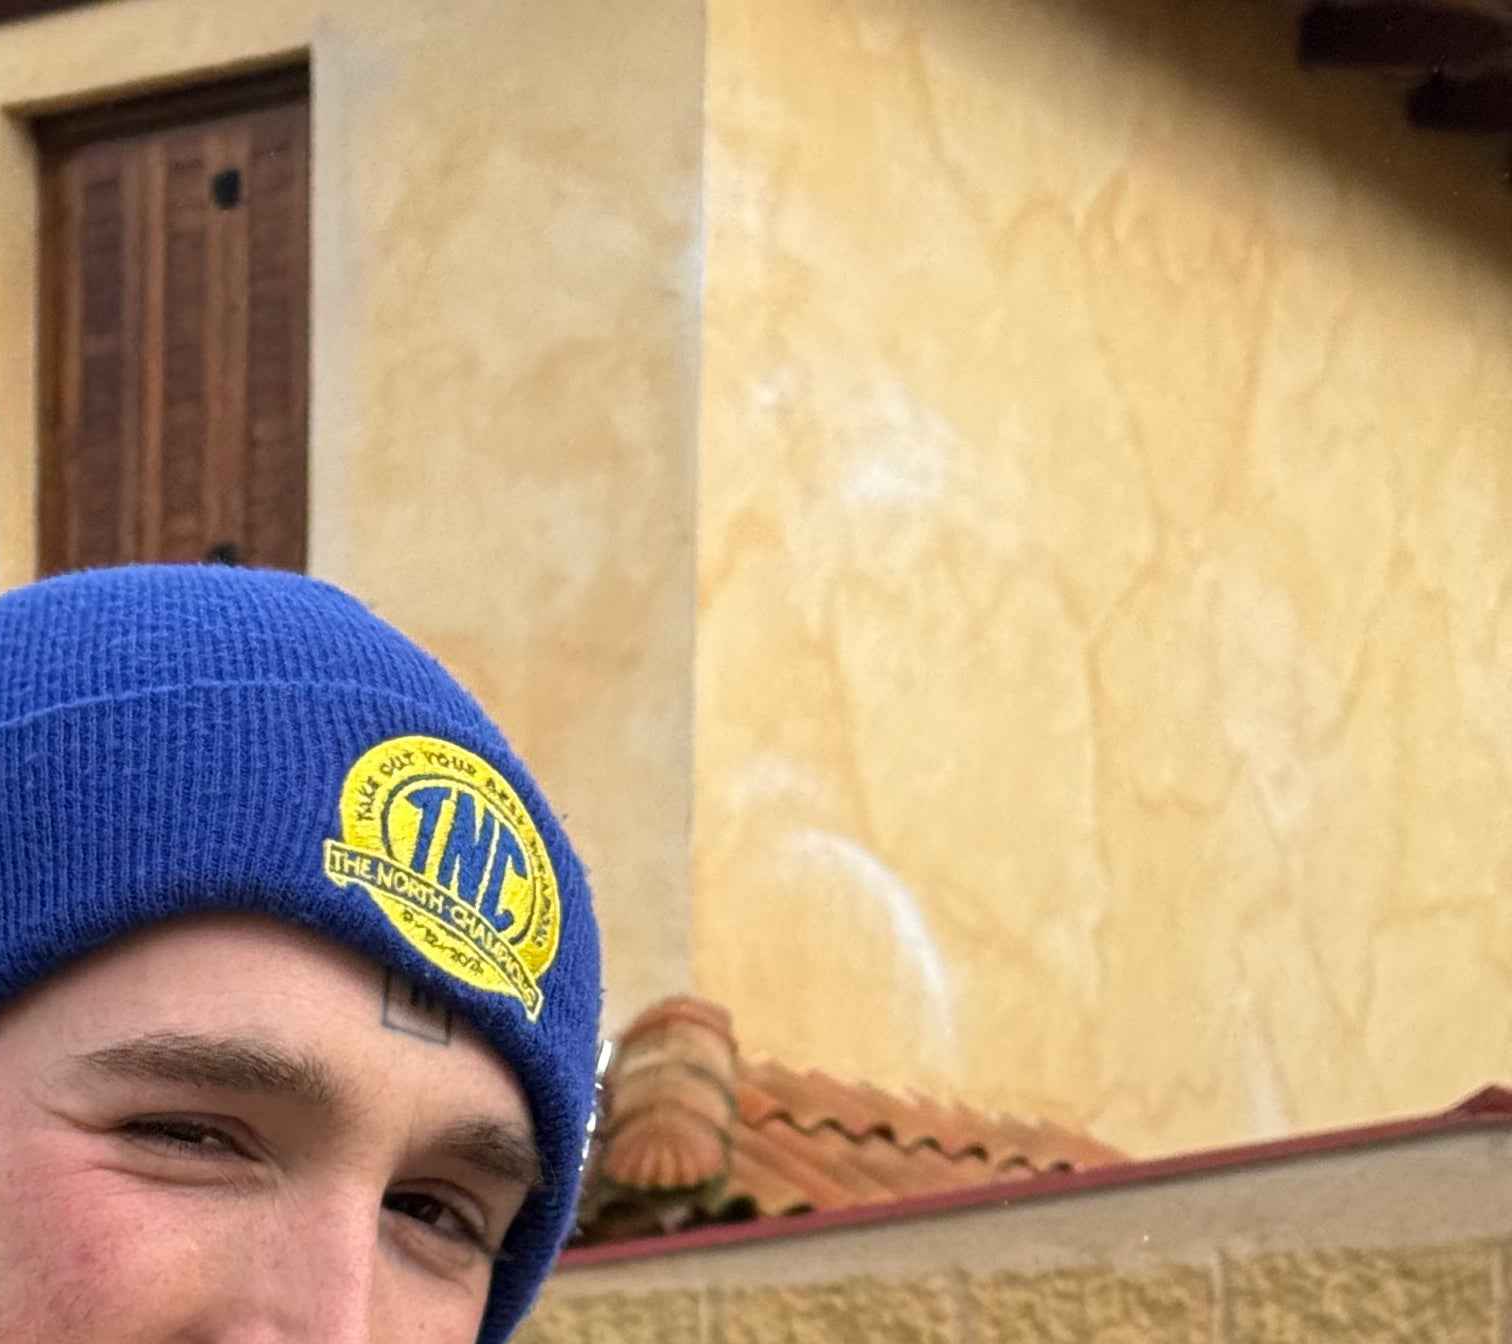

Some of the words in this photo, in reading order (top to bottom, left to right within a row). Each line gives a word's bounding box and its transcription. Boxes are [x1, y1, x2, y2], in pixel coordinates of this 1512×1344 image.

[331, 850, 372, 878] THE
[375, 865, 445, 912] NORTH
[405, 786, 529, 931] TNC
